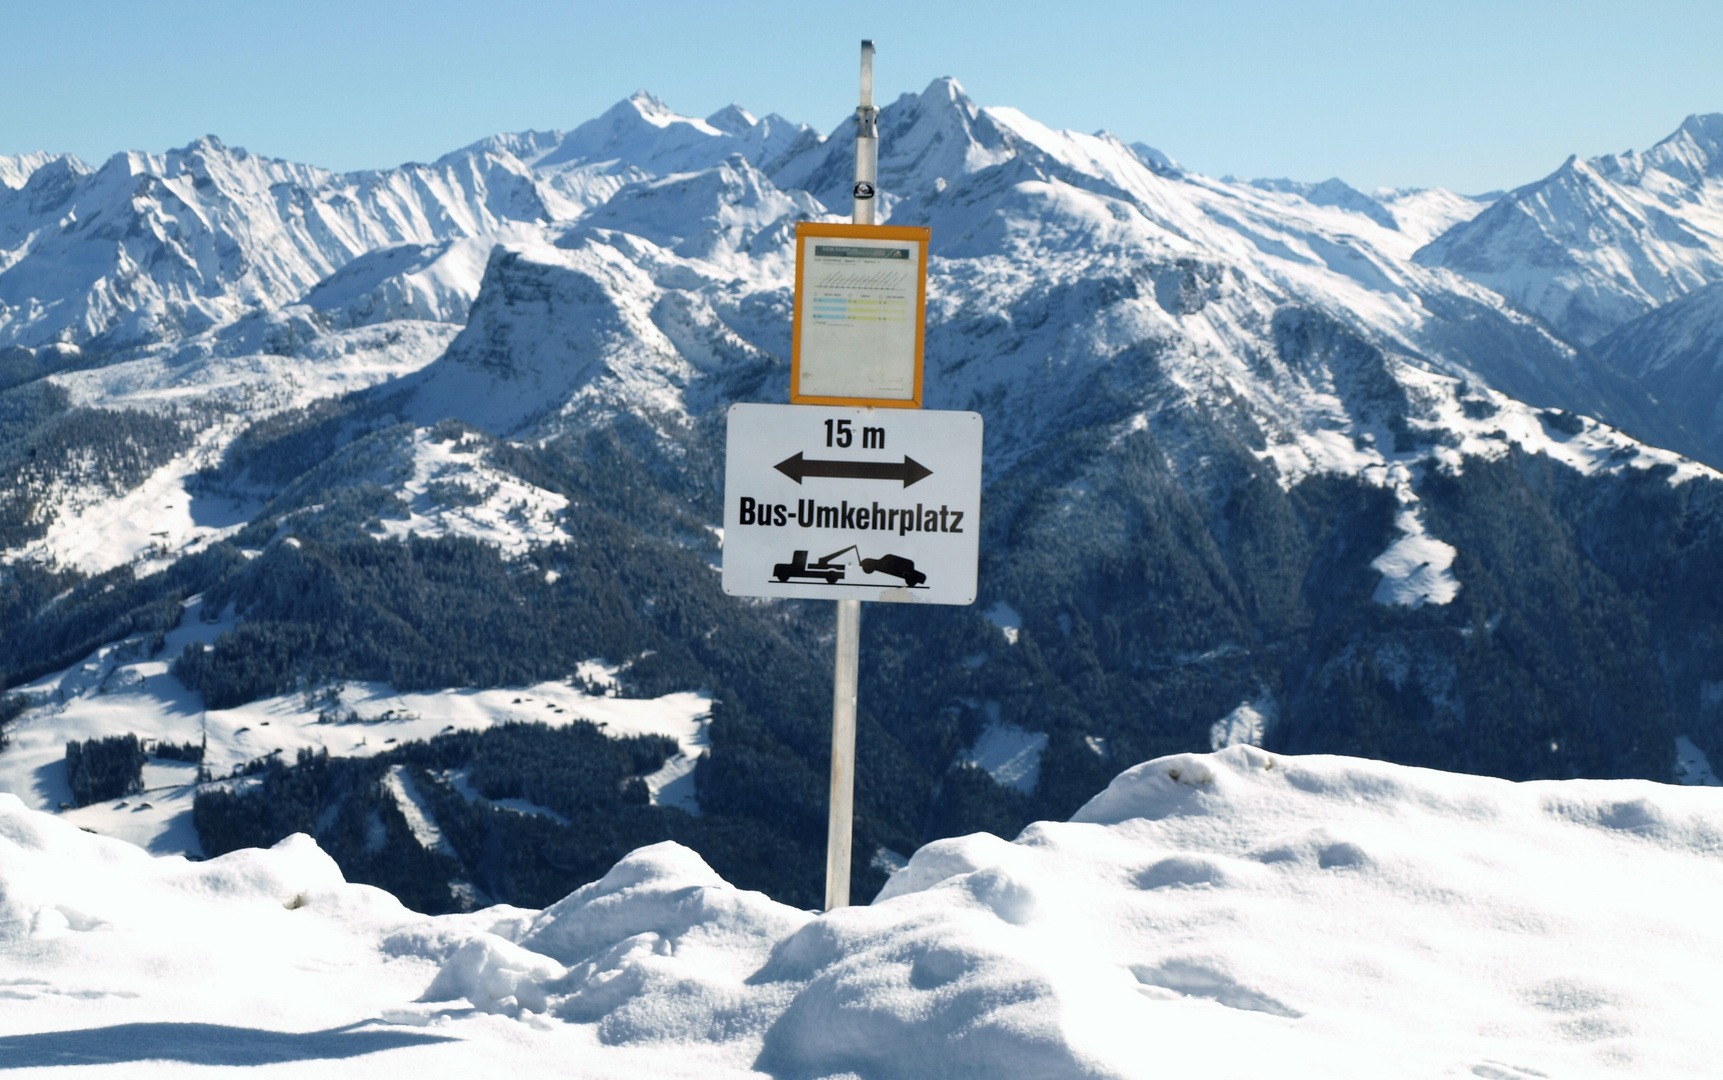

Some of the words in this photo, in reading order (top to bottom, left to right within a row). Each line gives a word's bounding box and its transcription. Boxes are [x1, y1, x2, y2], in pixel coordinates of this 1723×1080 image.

[824, 418, 852, 448] 15
[862, 425, 886, 449] m
[739, 496, 964, 536] Bus-Umkehrplatz
